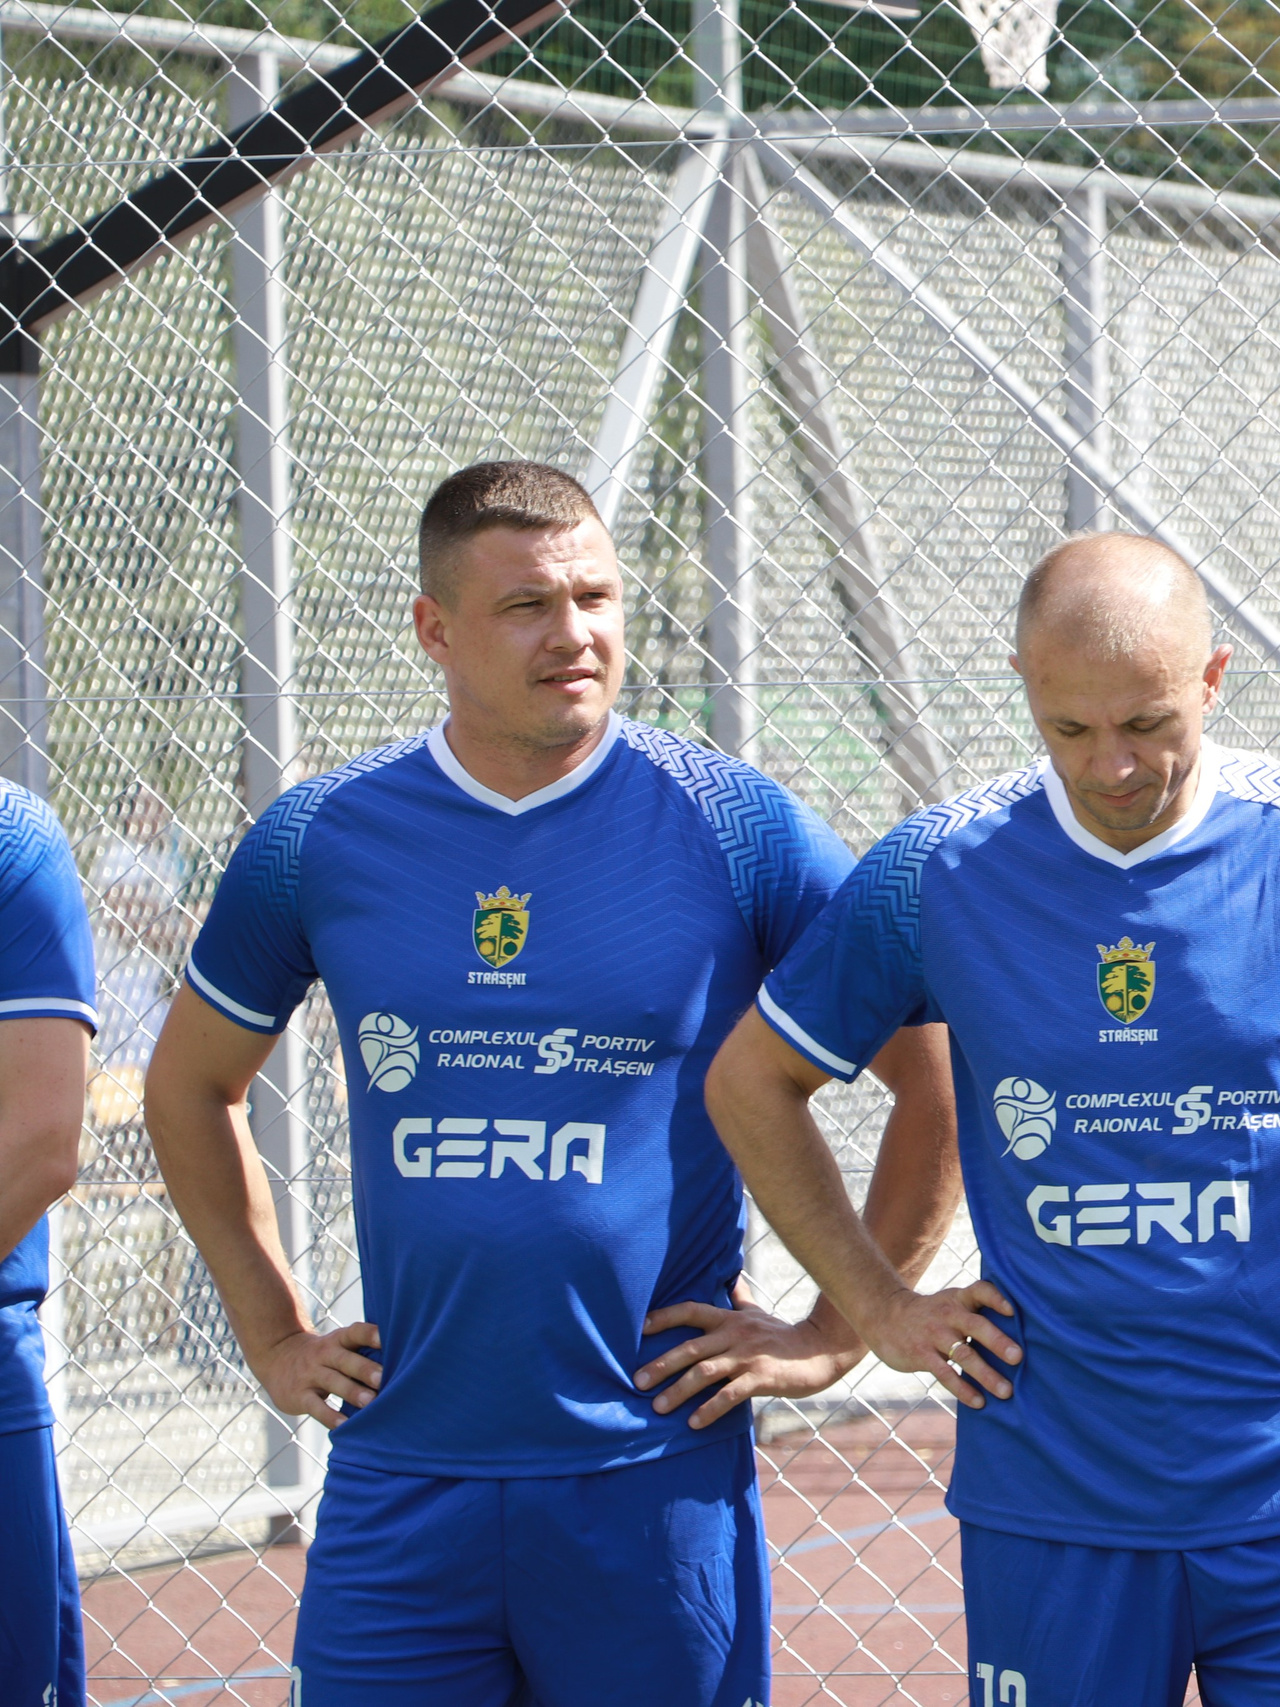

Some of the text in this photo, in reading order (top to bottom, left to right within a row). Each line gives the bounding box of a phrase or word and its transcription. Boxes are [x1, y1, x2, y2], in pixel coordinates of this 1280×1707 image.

[429, 1030, 539, 1046] COMPLEXUL
[437, 1054, 525, 1069] RAIONAL
[1065, 1092, 1174, 1109] COMPLEXUL
[1074, 1117, 1163, 1134] RAIONAL
[392, 1117, 606, 1184] GERA
[1026, 1180, 1250, 1246] GERA
